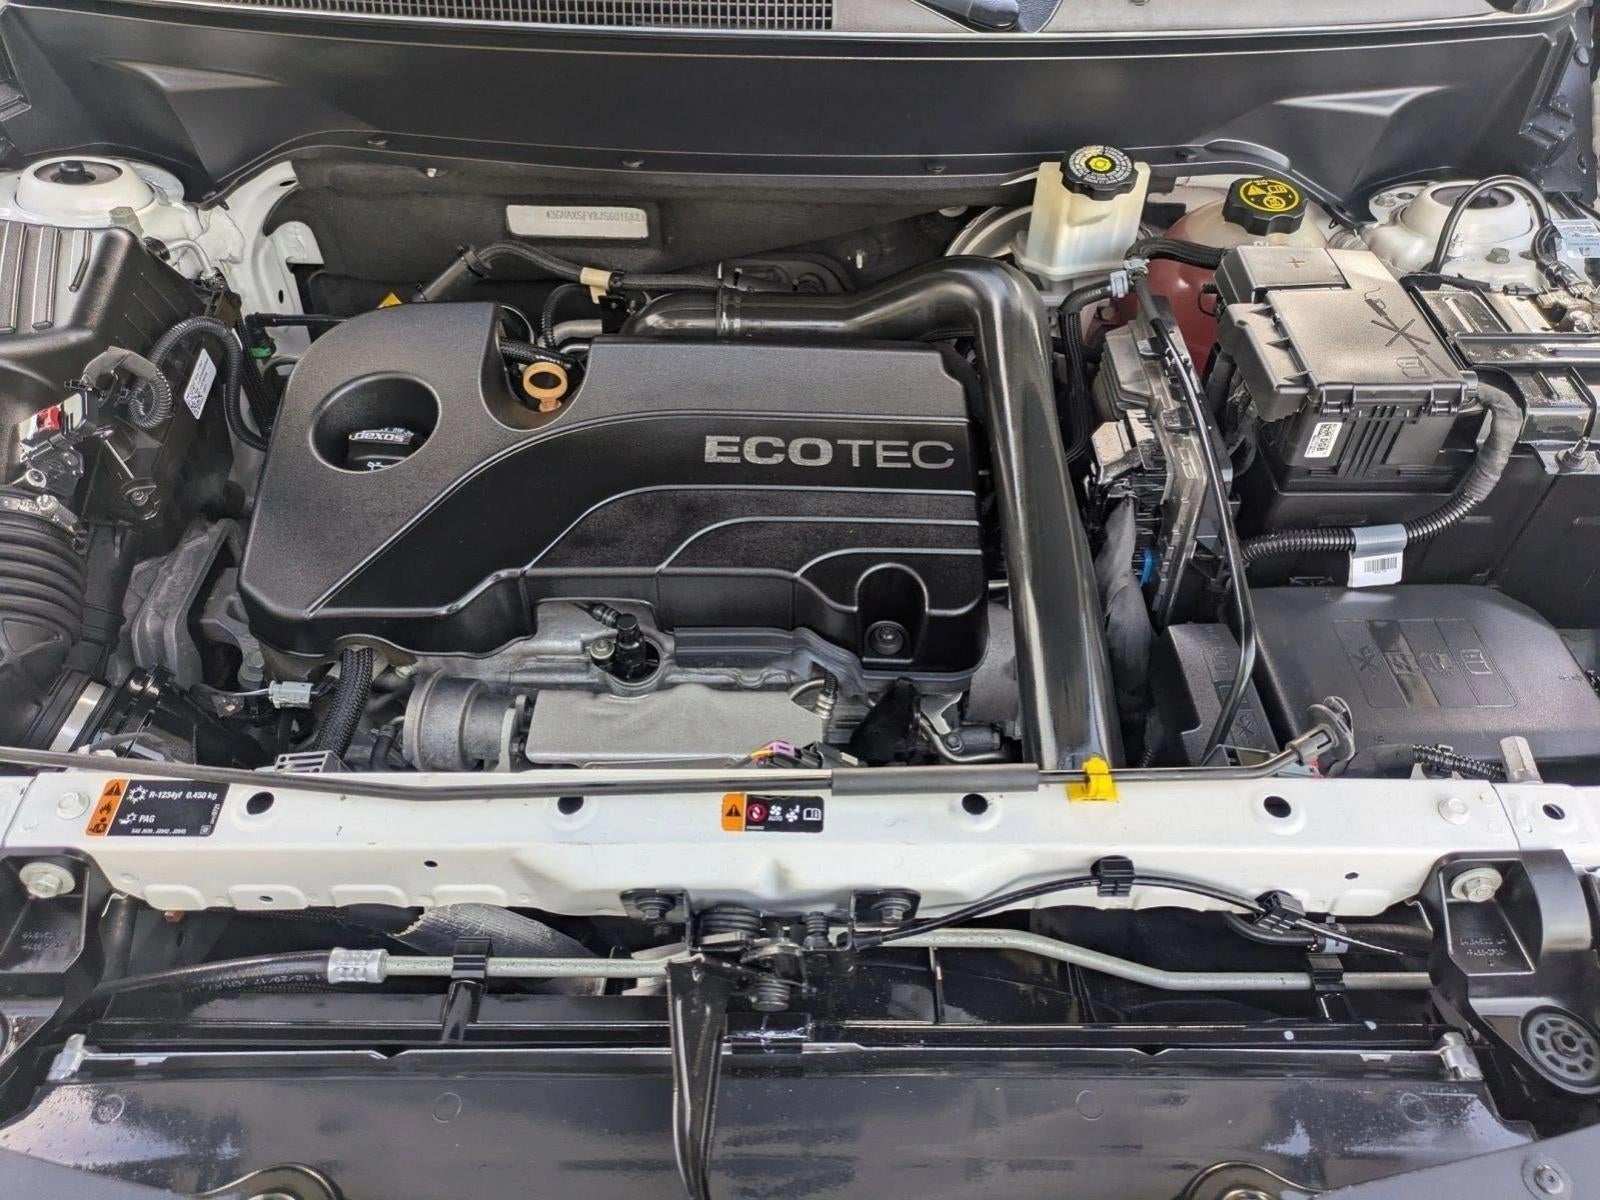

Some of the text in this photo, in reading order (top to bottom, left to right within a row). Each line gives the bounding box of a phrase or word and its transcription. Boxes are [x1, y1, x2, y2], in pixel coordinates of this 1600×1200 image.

[354, 430, 405, 442] dexos
[704, 436, 955, 469] ECOTEC
[149, 790, 218, 801] R-1234yf 0.450 kg
[139, 815, 155, 823] PAG
